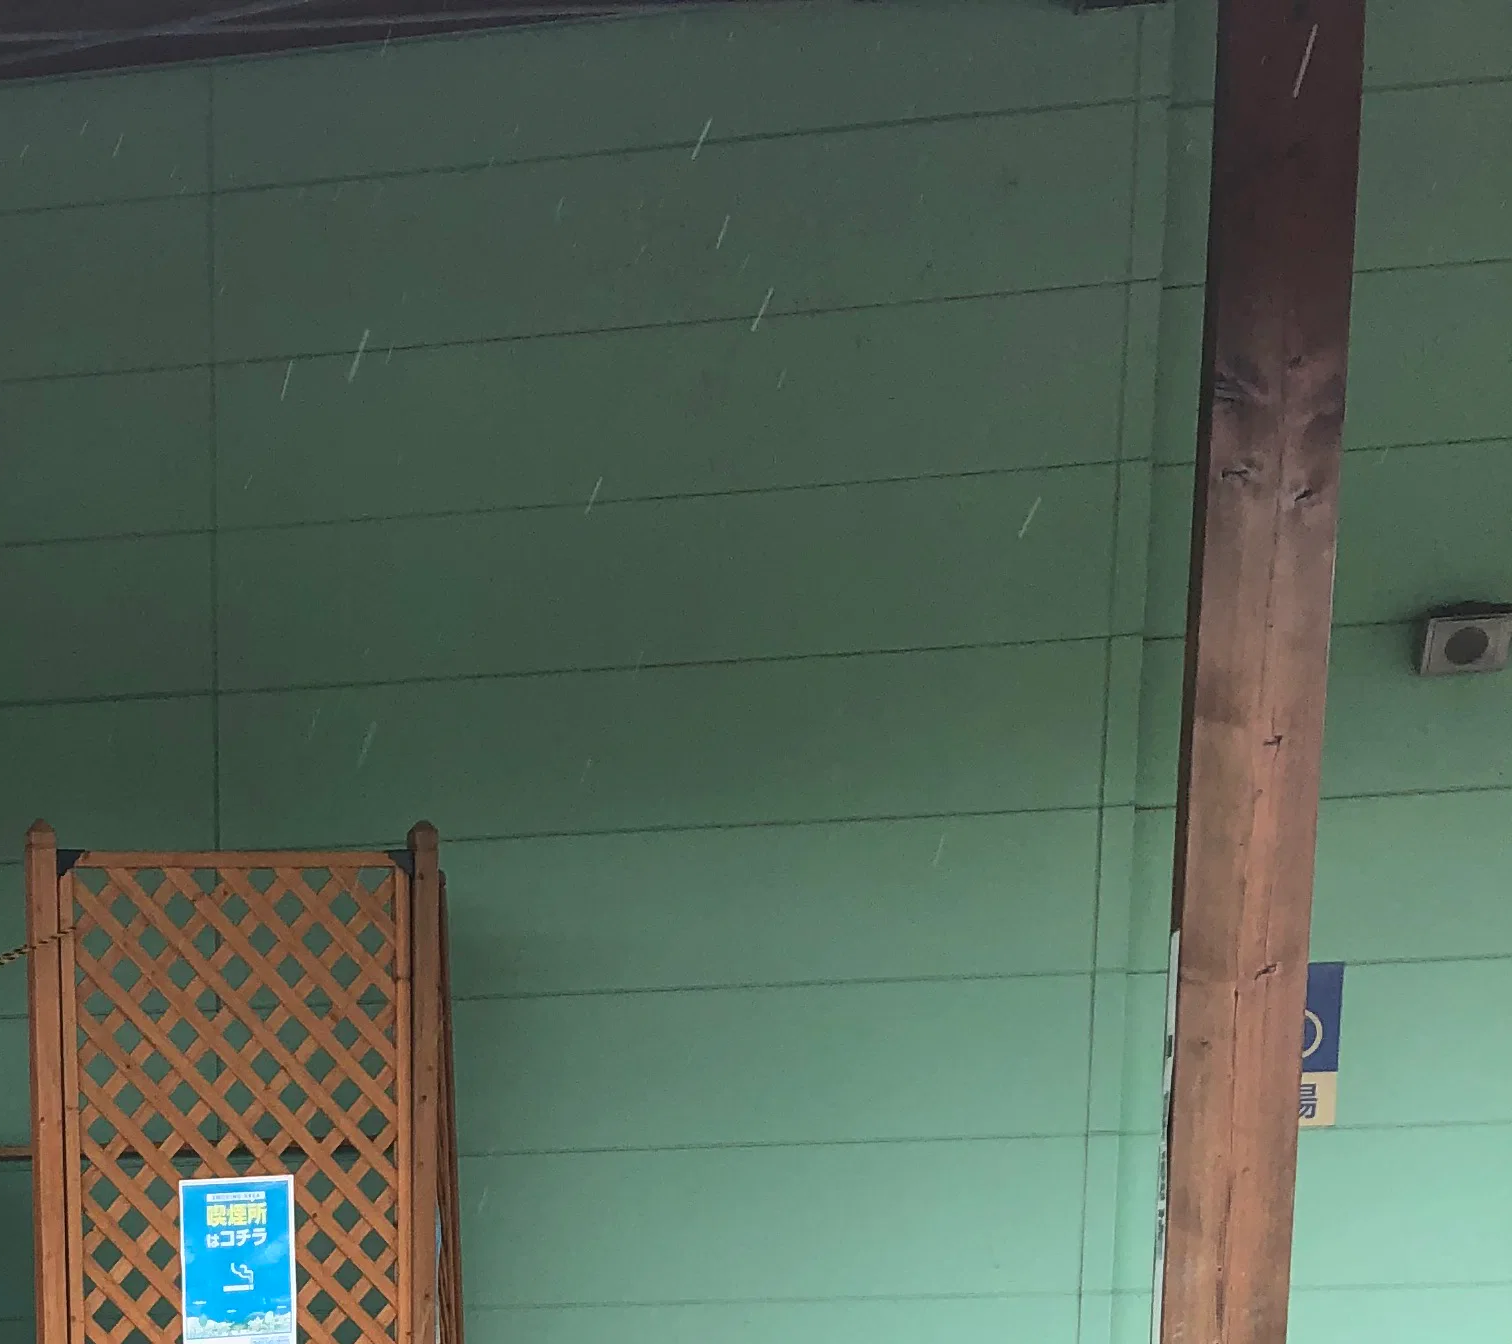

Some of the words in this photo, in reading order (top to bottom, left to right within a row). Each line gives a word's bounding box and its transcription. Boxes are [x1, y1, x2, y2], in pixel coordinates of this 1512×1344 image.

[207, 1202, 267, 1227] 喫煙所
[206, 1228, 267, 1248] はコチラ
